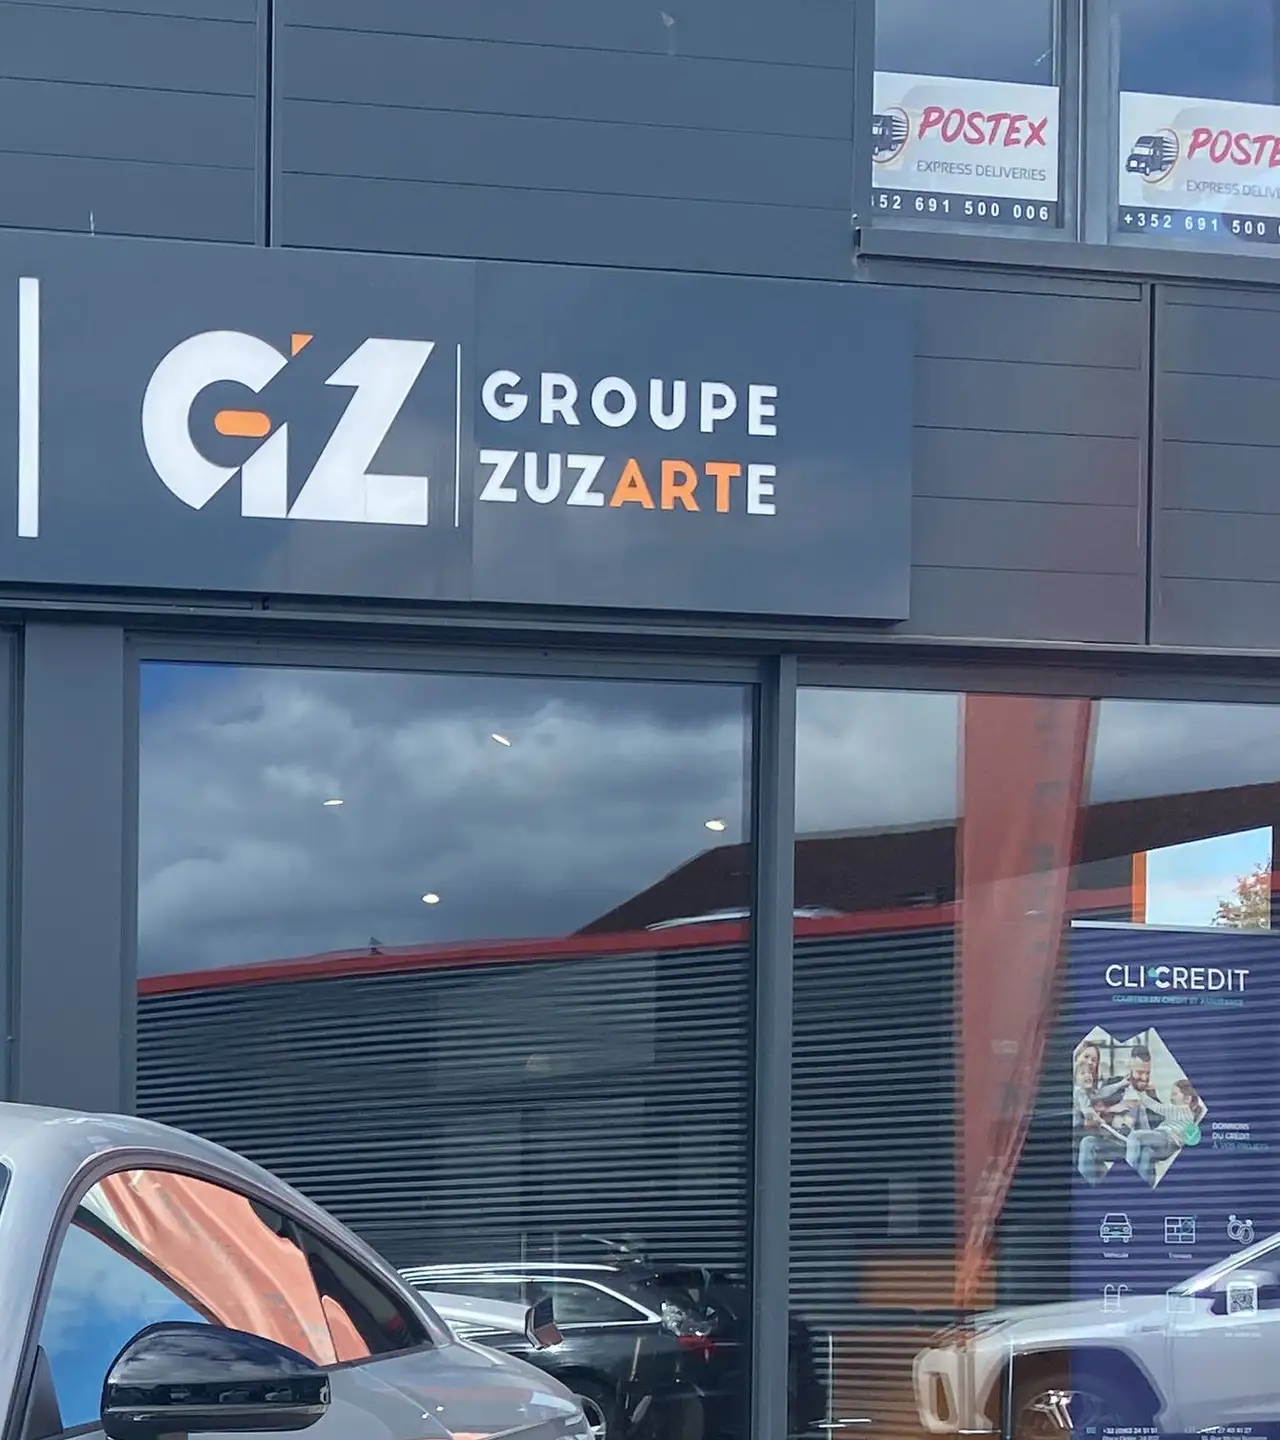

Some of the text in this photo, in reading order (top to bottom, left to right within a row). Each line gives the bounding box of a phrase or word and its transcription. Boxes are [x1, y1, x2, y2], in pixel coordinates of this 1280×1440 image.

[917, 106, 1048, 149] POSTEX
[916, 159, 1047, 182] EXPRESS DELIVERIES
[1186, 179, 1239, 196] EXPRESS
[914, 196, 951, 213] 691
[963, 200, 1000, 217] 500
[1012, 203, 1049, 221] 006
[1124, 212, 1266, 236] +352 691 500
[480, 368, 778, 437] GROUPE
[477, 448, 778, 517] ZUZARTE
